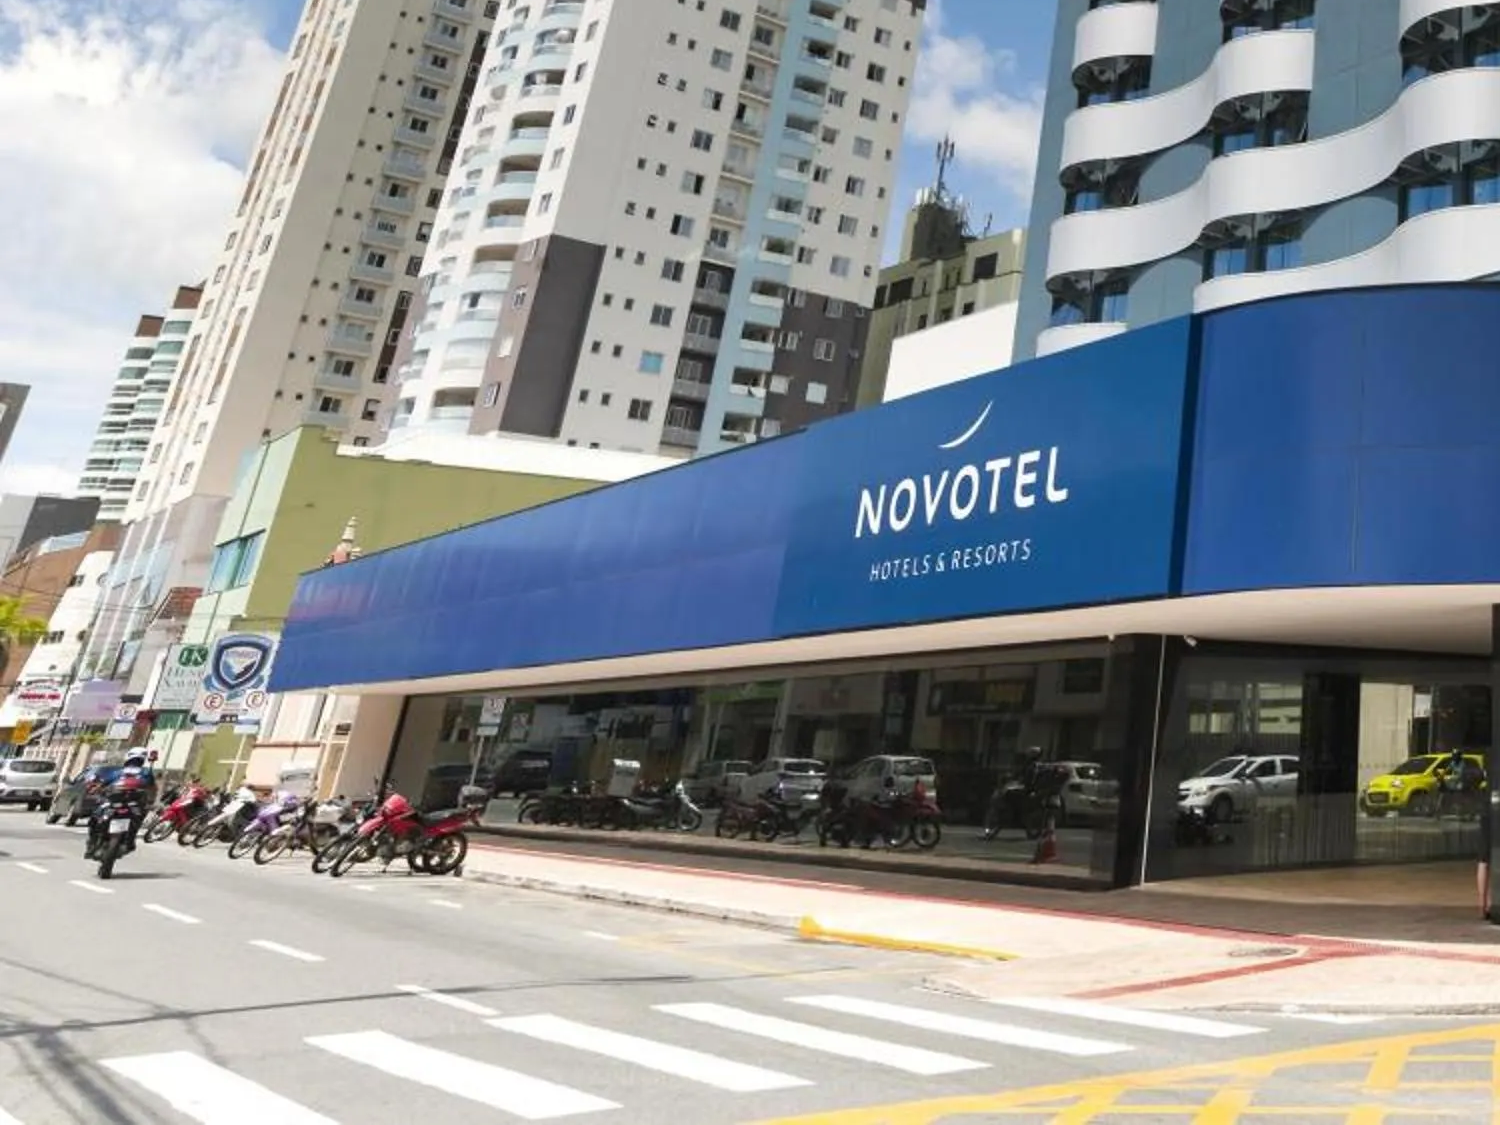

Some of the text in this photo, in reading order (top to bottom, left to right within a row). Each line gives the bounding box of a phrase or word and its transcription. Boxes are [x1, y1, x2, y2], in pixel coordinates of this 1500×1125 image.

[855, 446, 1068, 538] NOVOTEL
[869, 538, 1031, 582] HOTELS & RESORTS
